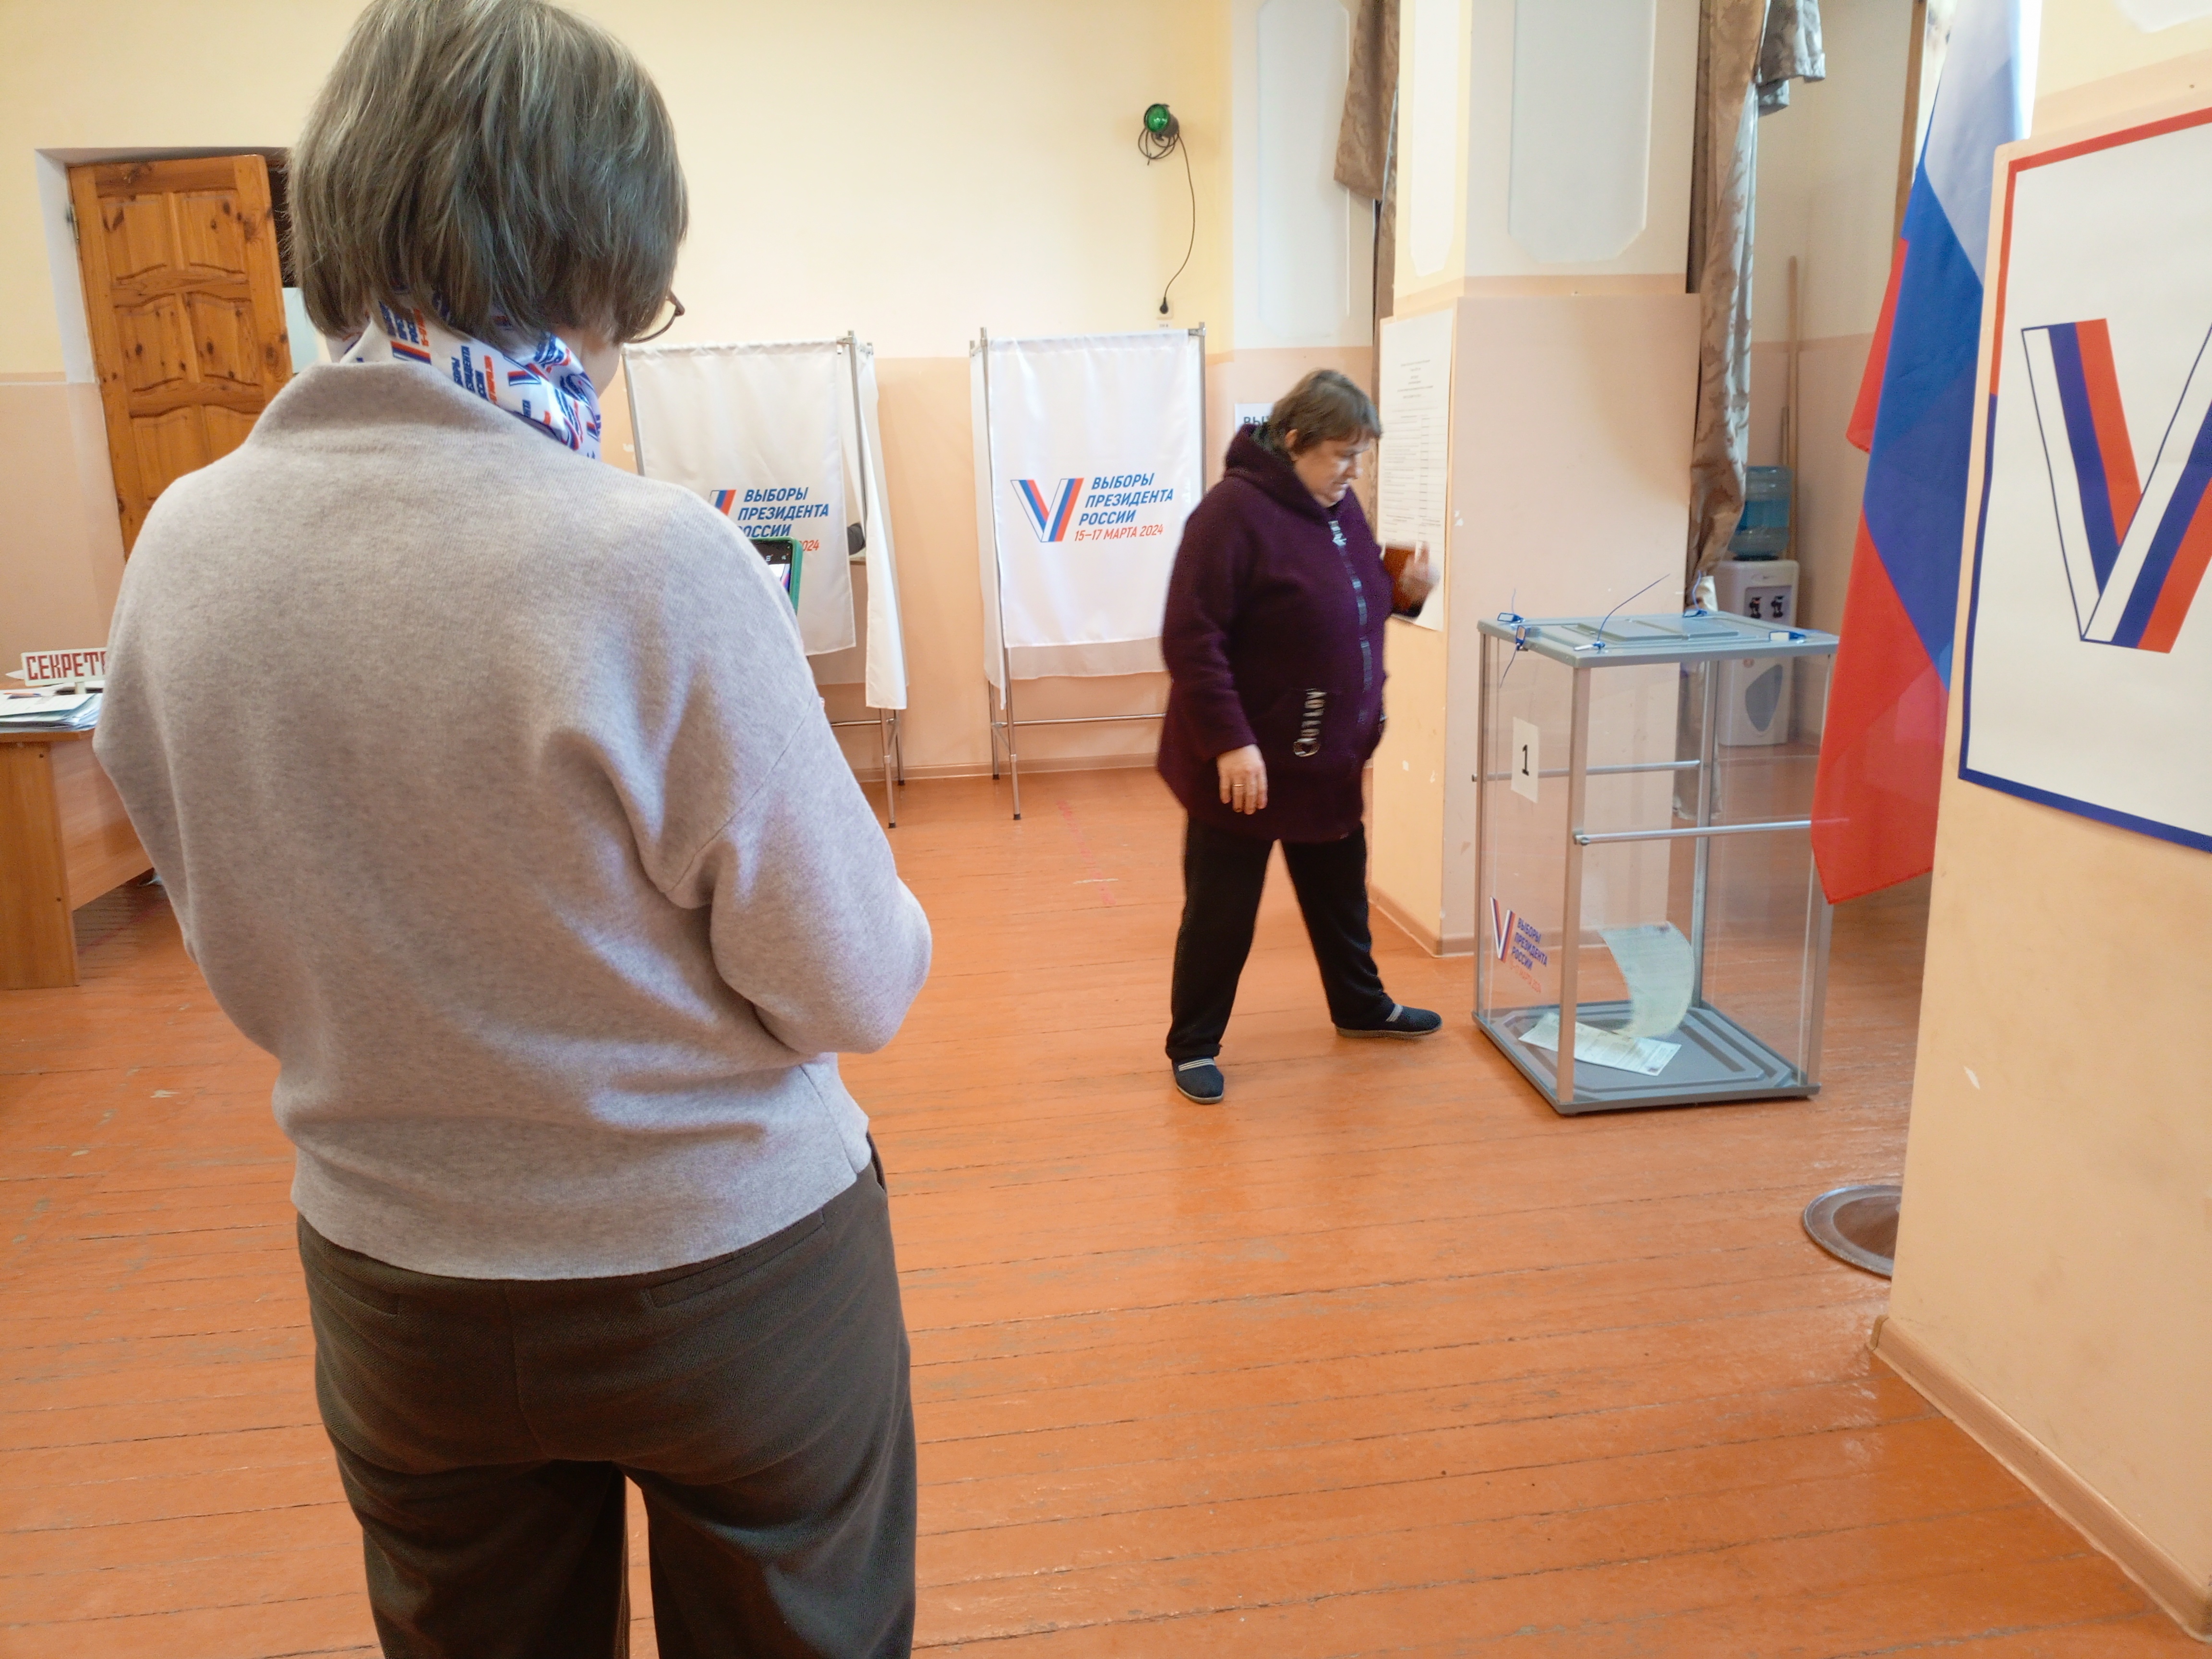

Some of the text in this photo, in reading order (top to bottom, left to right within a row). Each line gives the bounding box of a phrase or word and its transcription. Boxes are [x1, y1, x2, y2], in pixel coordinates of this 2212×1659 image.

[1092, 473, 1155, 490] ВЫБОРЫ
[744, 487, 809, 503] ВЫБОРЫ
[1085, 489, 1174, 508] ПРЕЗИДЕНТА
[737, 504, 830, 521] ПРЕЗИДЕНТА
[1079, 510, 1137, 526] РОССИИ
[1104, 527, 1137, 540] МАРТА
[1140, 524, 1164, 537] 2024
[800, 540, 820, 552] 024
[1521, 744, 1529, 776] 1
[1517, 917, 1541, 944] ВЫБОРЫ
[1514, 931, 1548, 967] ПРЕЗИДЕНТА
[1511, 946, 1533, 971] РОССИИ
